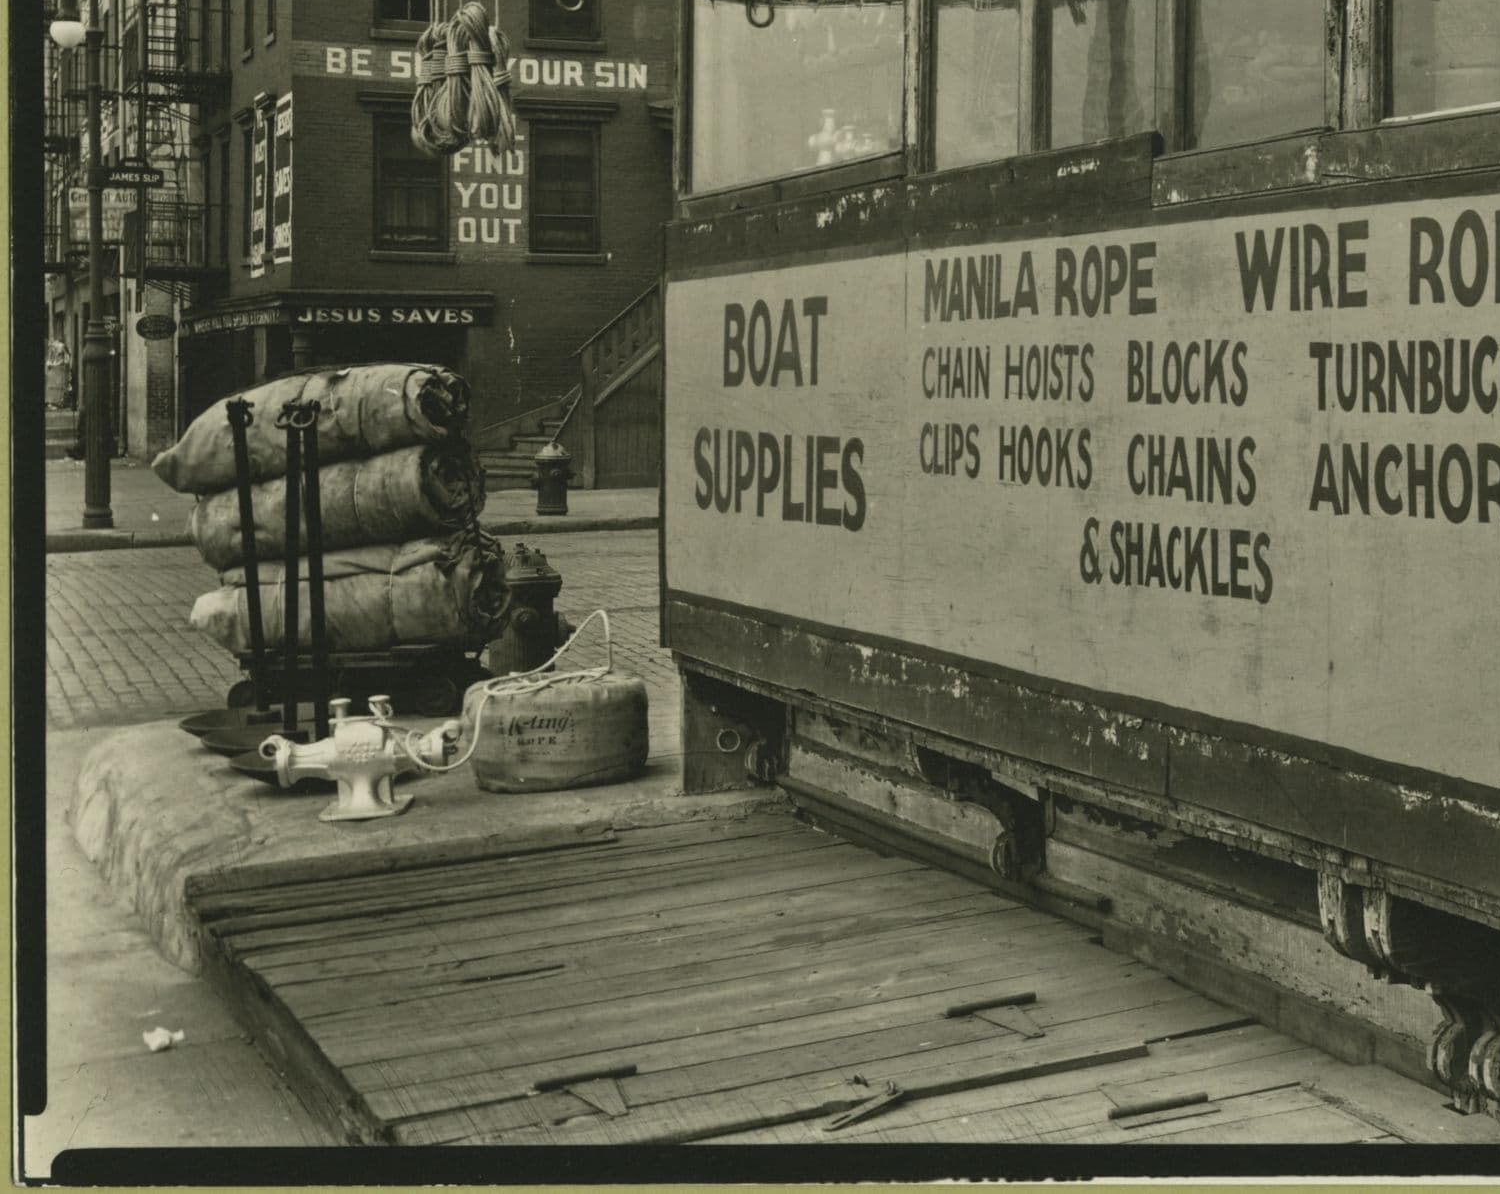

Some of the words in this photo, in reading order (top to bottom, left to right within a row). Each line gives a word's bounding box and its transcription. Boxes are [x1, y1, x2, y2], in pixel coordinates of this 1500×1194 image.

[325, 47, 373, 76] BE
[594, 61, 648, 89] SIN
[109, 173, 140, 183] JAMES
[143, 173, 160, 183] SLIP
[453, 146, 525, 176] FIND
[453, 182, 523, 210] YOU
[458, 217, 523, 244] OUT
[924, 251, 1039, 322] MANILA
[1055, 242, 1156, 318] ROPE
[1234, 219, 1369, 313] WIRE
[297, 307, 381, 323] JESUS
[392, 307, 475, 325] SAVES
[723, 297, 827, 387] BOAT
[923, 346, 990, 399] CHAIN
[1005, 343, 1094, 402] HOISTS
[1128, 339, 1248, 406] BLOCKS
[694, 427, 866, 532] SUPPLIES
[920, 423, 980, 479] CLIPS
[999, 425, 1092, 490] HOOKS
[1127, 434, 1256, 506] CHAINS
[1080, 517, 1103, 584] &
[1110, 521, 1272, 604] SHACKLES
